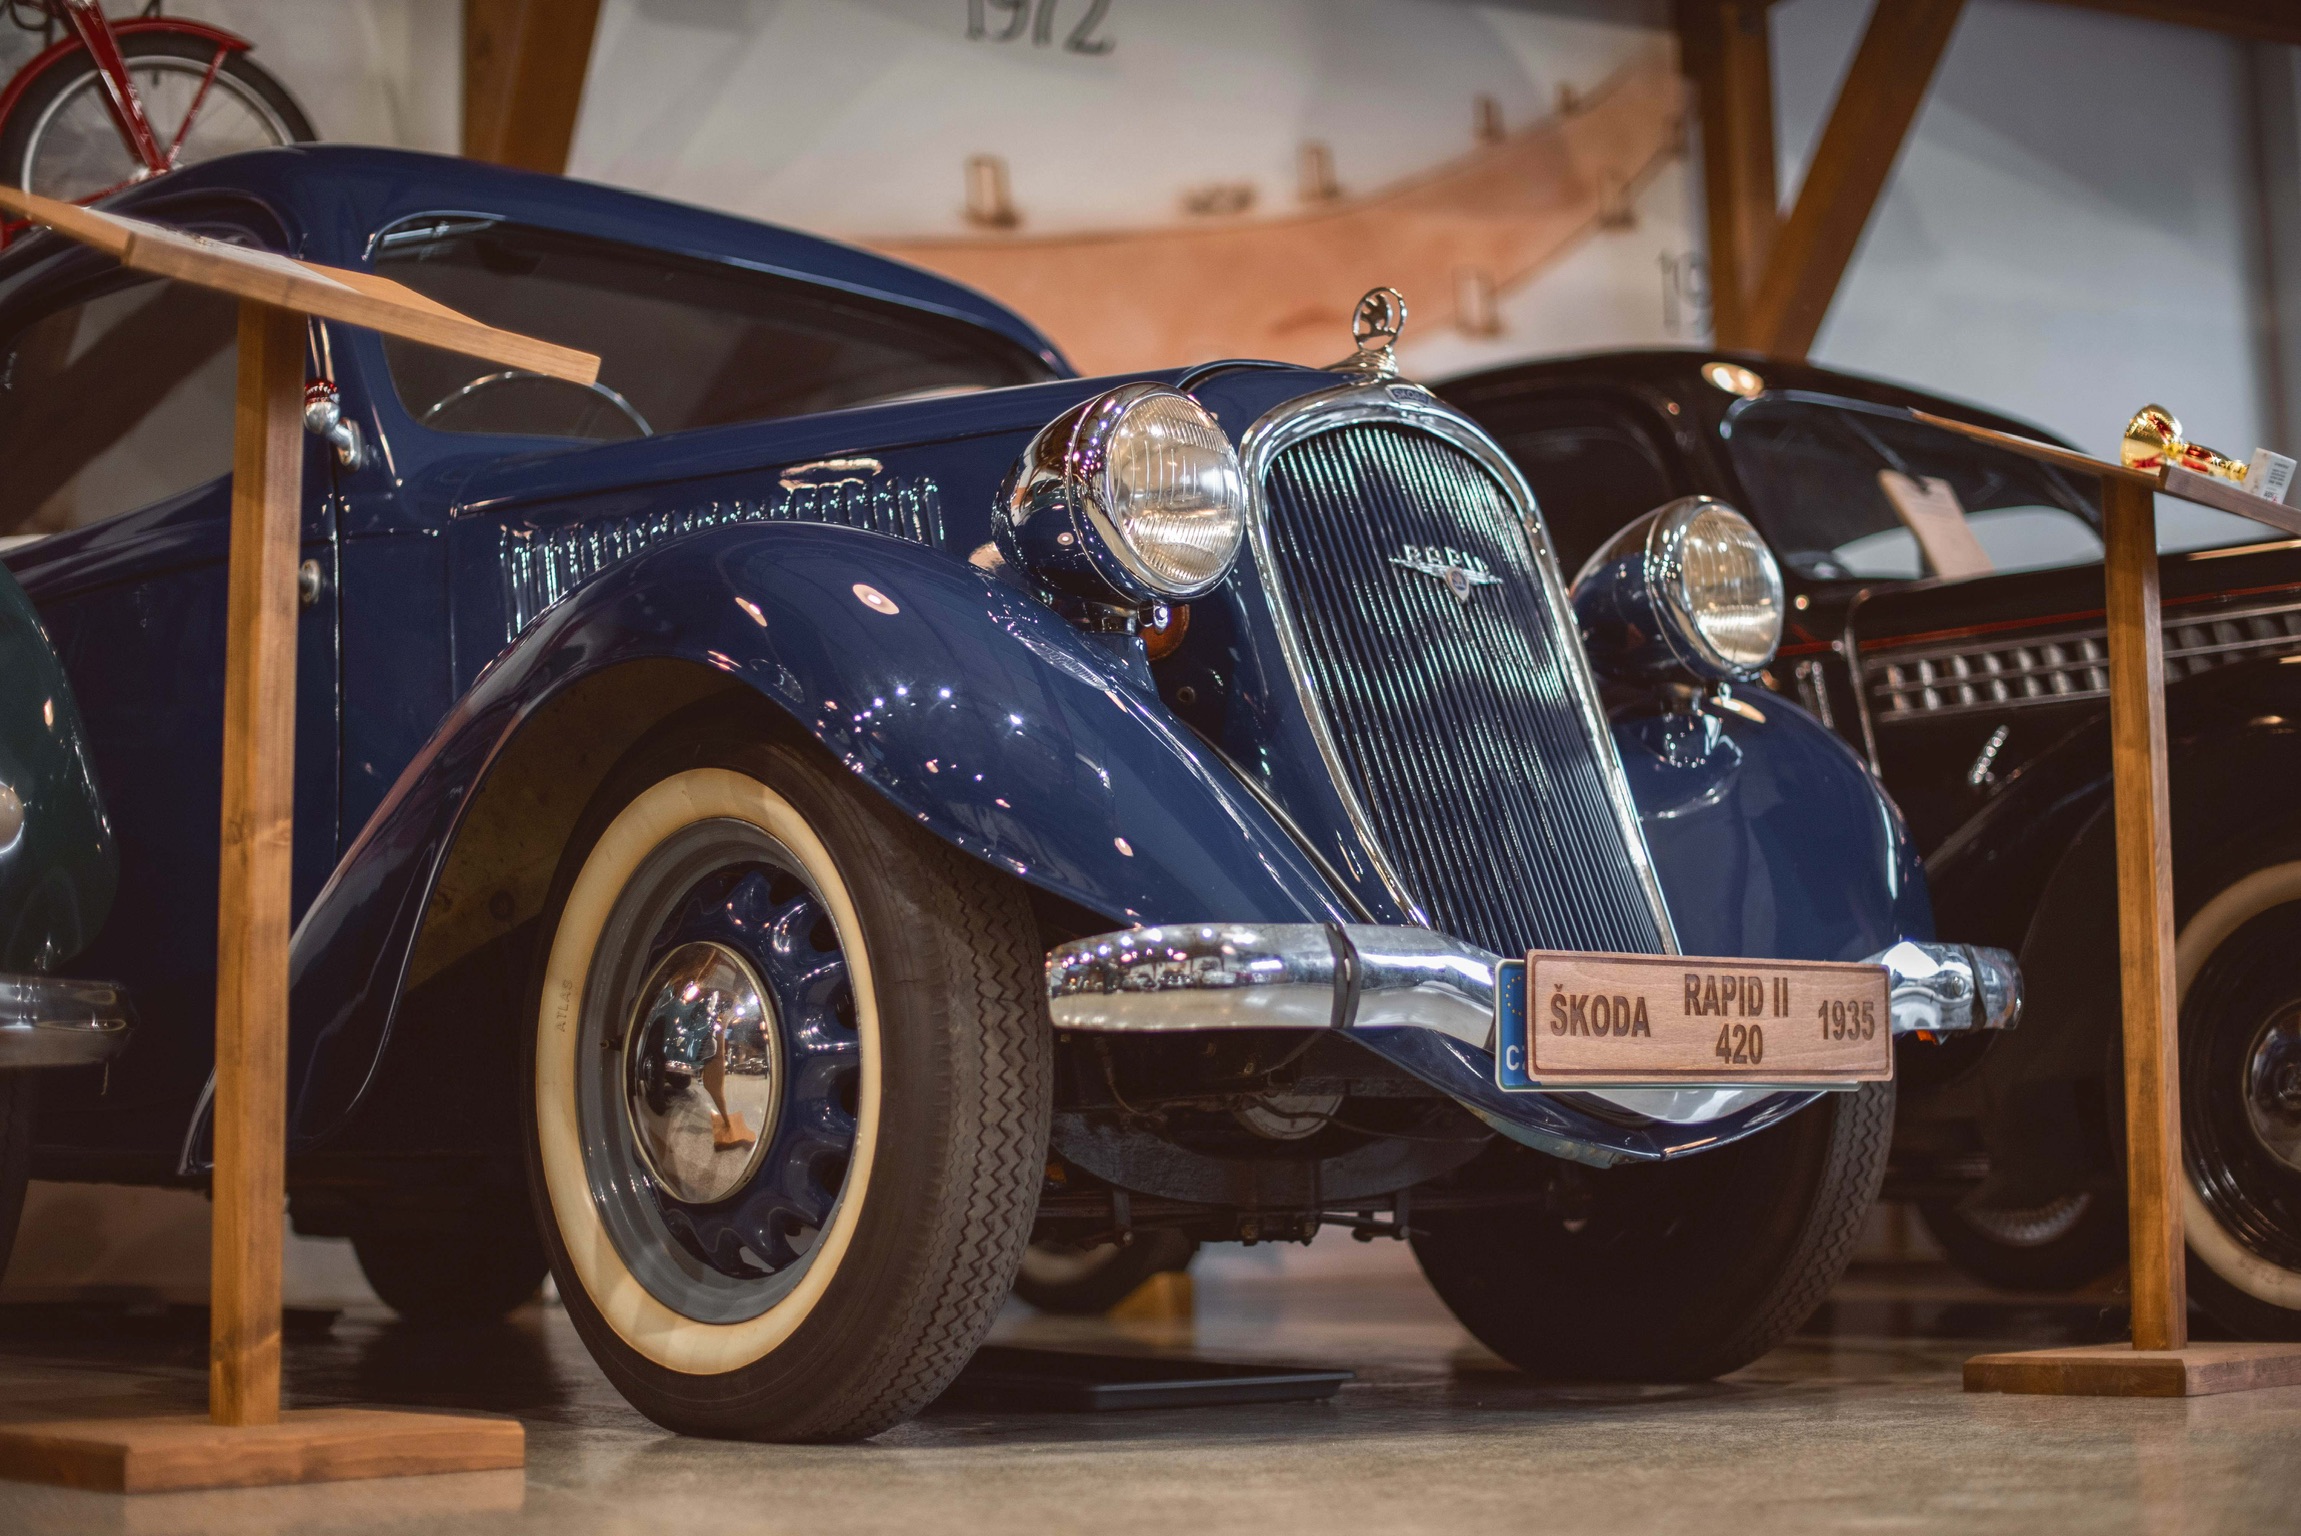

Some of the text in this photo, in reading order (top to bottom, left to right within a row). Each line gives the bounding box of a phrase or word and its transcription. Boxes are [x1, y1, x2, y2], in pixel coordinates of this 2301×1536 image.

[556, 979, 573, 1033] ATLAS
[1550, 983, 1651, 1037] ŠKODA
[1684, 973, 1789, 1017] RAPID II
[1818, 1000, 1875, 1041] 1935
[1506, 1045, 1526, 1071] C
[1715, 1023, 1764, 1065] 420
